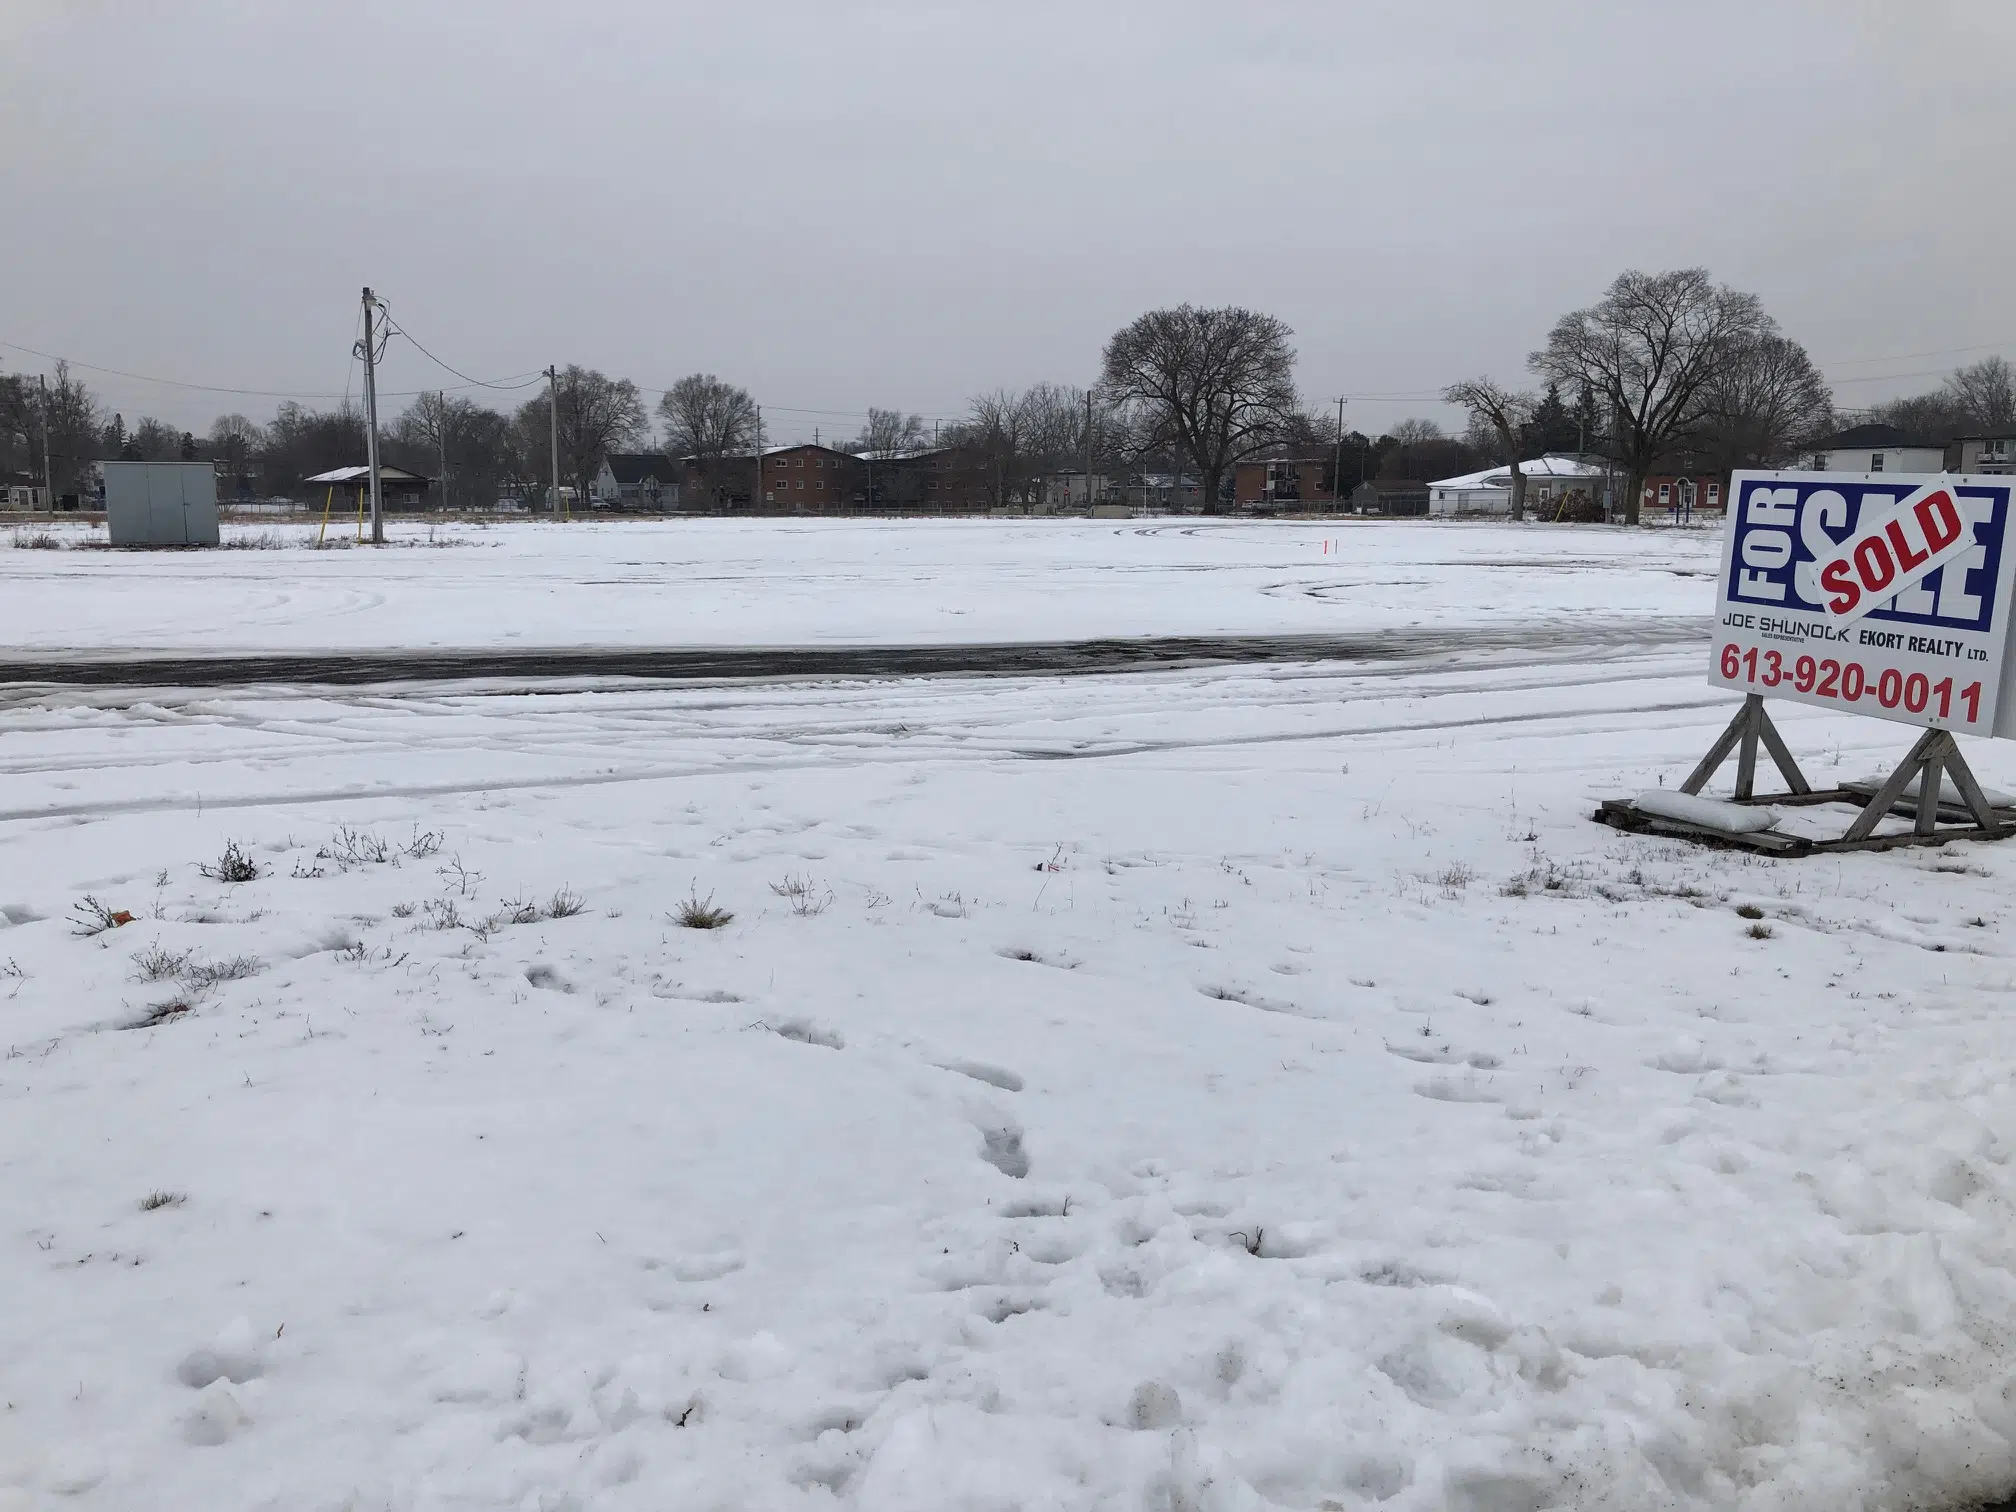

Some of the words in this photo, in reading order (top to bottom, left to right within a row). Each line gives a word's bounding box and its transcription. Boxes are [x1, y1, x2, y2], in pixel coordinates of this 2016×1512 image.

[1738, 487, 1798, 600] FOR
[1795, 489, 1995, 621] SE
[1820, 490, 1962, 615] SOLD
[1723, 613, 1755, 630] JOE
[1759, 617, 1851, 643] SHUNOCK
[1859, 629, 1904, 650] EKORT
[1908, 636, 1964, 658] REALTY
[1967, 648, 1989, 662] LTD.
[1720, 643, 1981, 723] 613-920-0011
